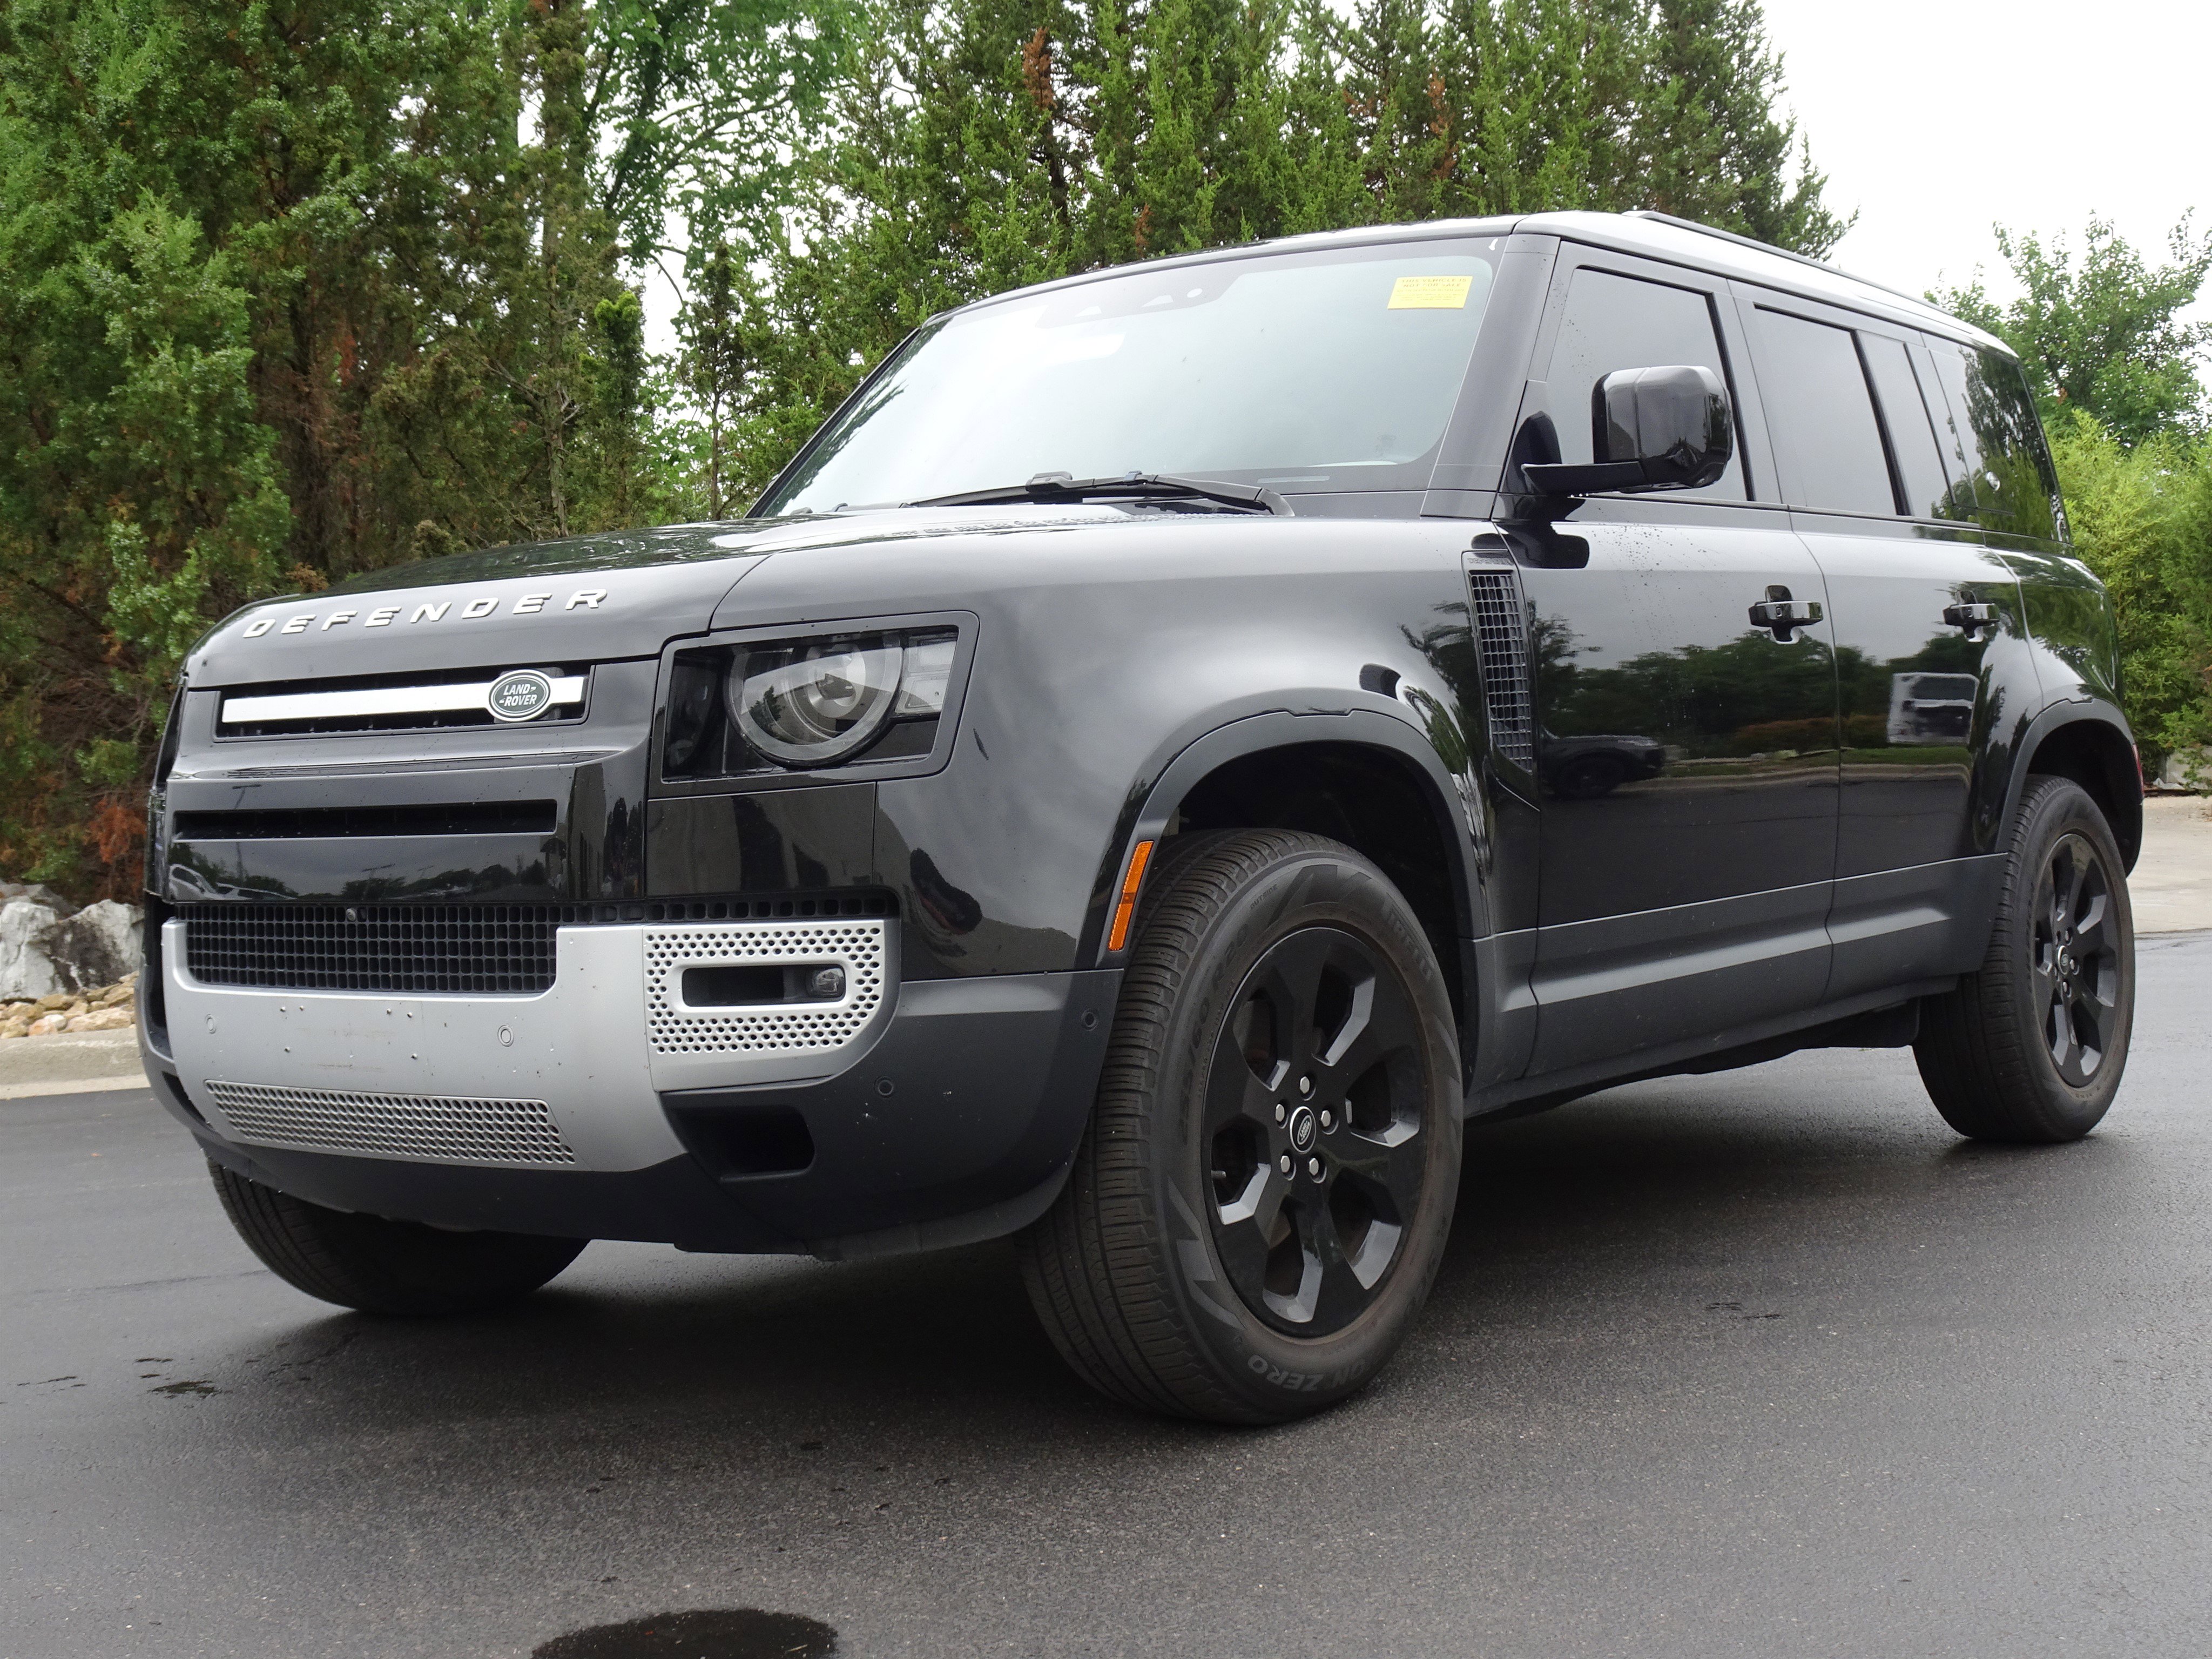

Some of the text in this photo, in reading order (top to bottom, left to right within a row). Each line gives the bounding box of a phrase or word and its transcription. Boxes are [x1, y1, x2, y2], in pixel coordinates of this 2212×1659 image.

[242, 588, 608, 638] DEFENDER
[503, 683, 531, 696] LAND
[504, 694, 538, 707] ROVER
[1247, 1354, 1324, 1392] ZERO
